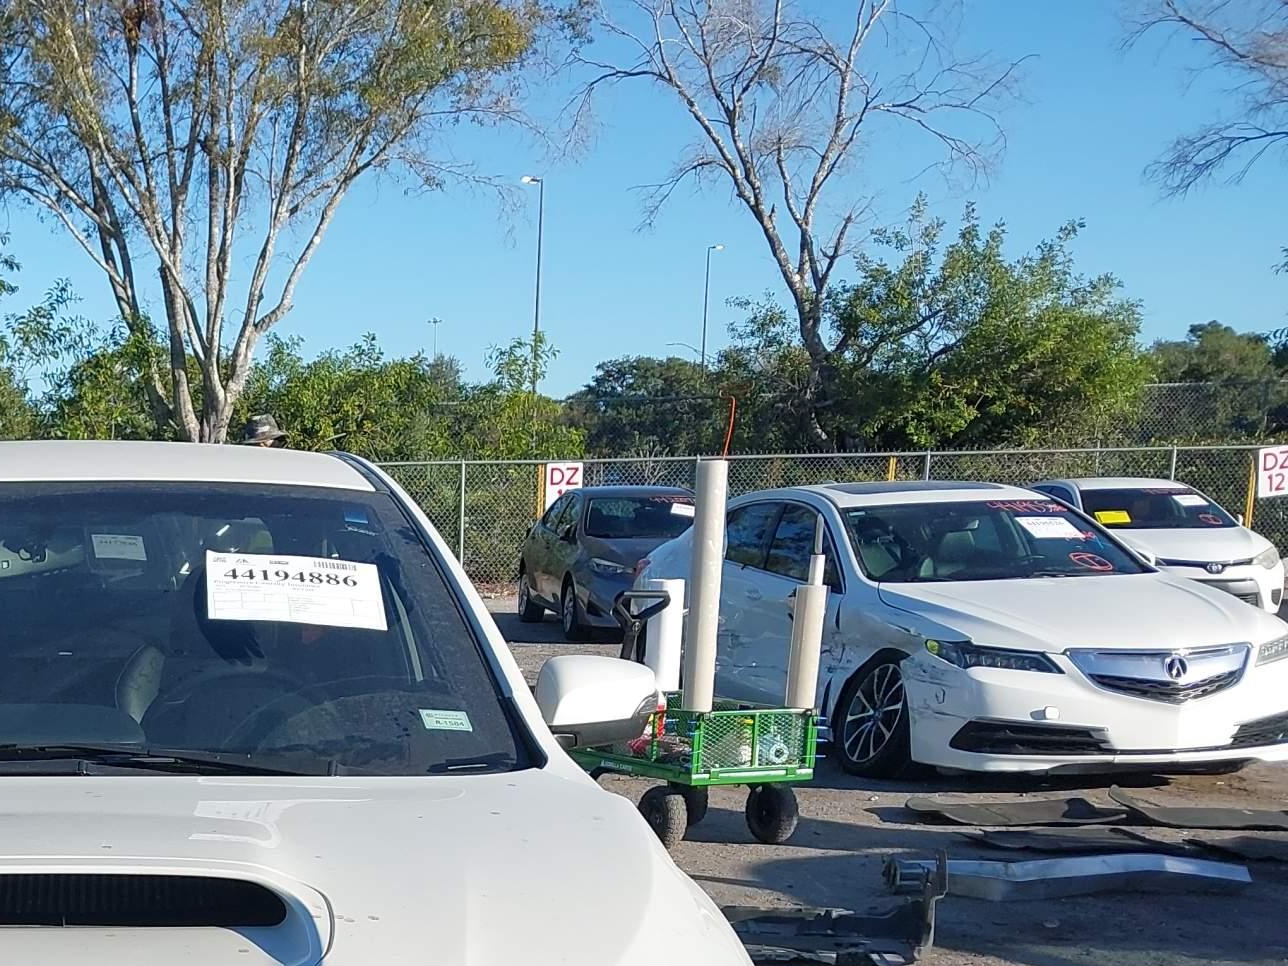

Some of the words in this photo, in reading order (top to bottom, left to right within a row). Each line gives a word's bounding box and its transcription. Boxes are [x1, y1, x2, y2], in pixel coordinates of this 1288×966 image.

[550, 467, 579, 486] DZ
[1267, 472, 1285, 492] 12
[223, 568, 358, 587] 44194886
